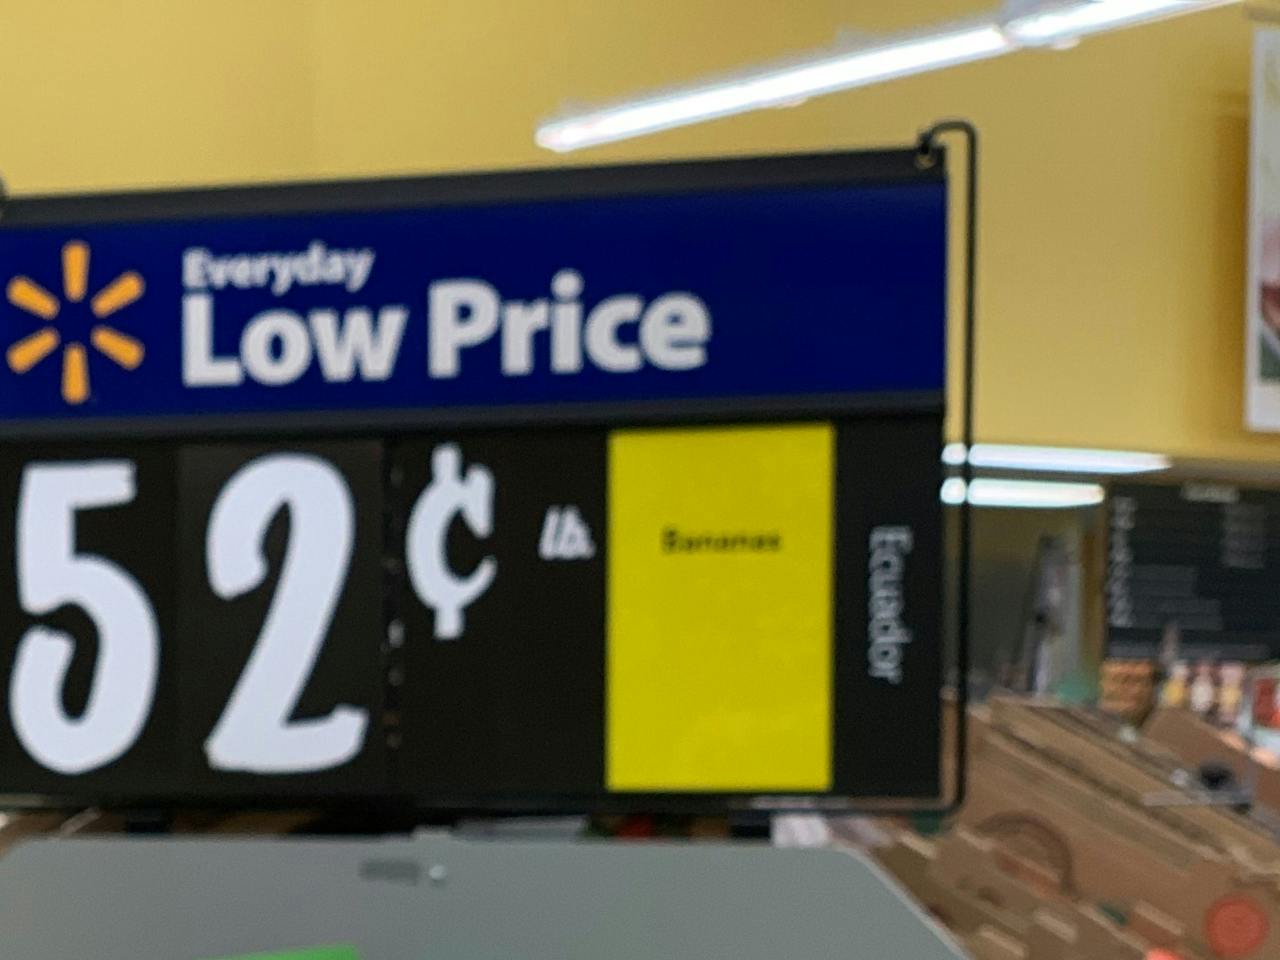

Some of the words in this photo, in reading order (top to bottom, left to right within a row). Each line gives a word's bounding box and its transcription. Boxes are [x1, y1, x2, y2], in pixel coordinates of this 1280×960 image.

[182, 238, 375, 294] Everyday
[182, 291, 409, 387] Low
[428, 268, 713, 379] Price
[662, 526, 783, 554] Bananas
[868, 526, 913, 685] Ecuador
